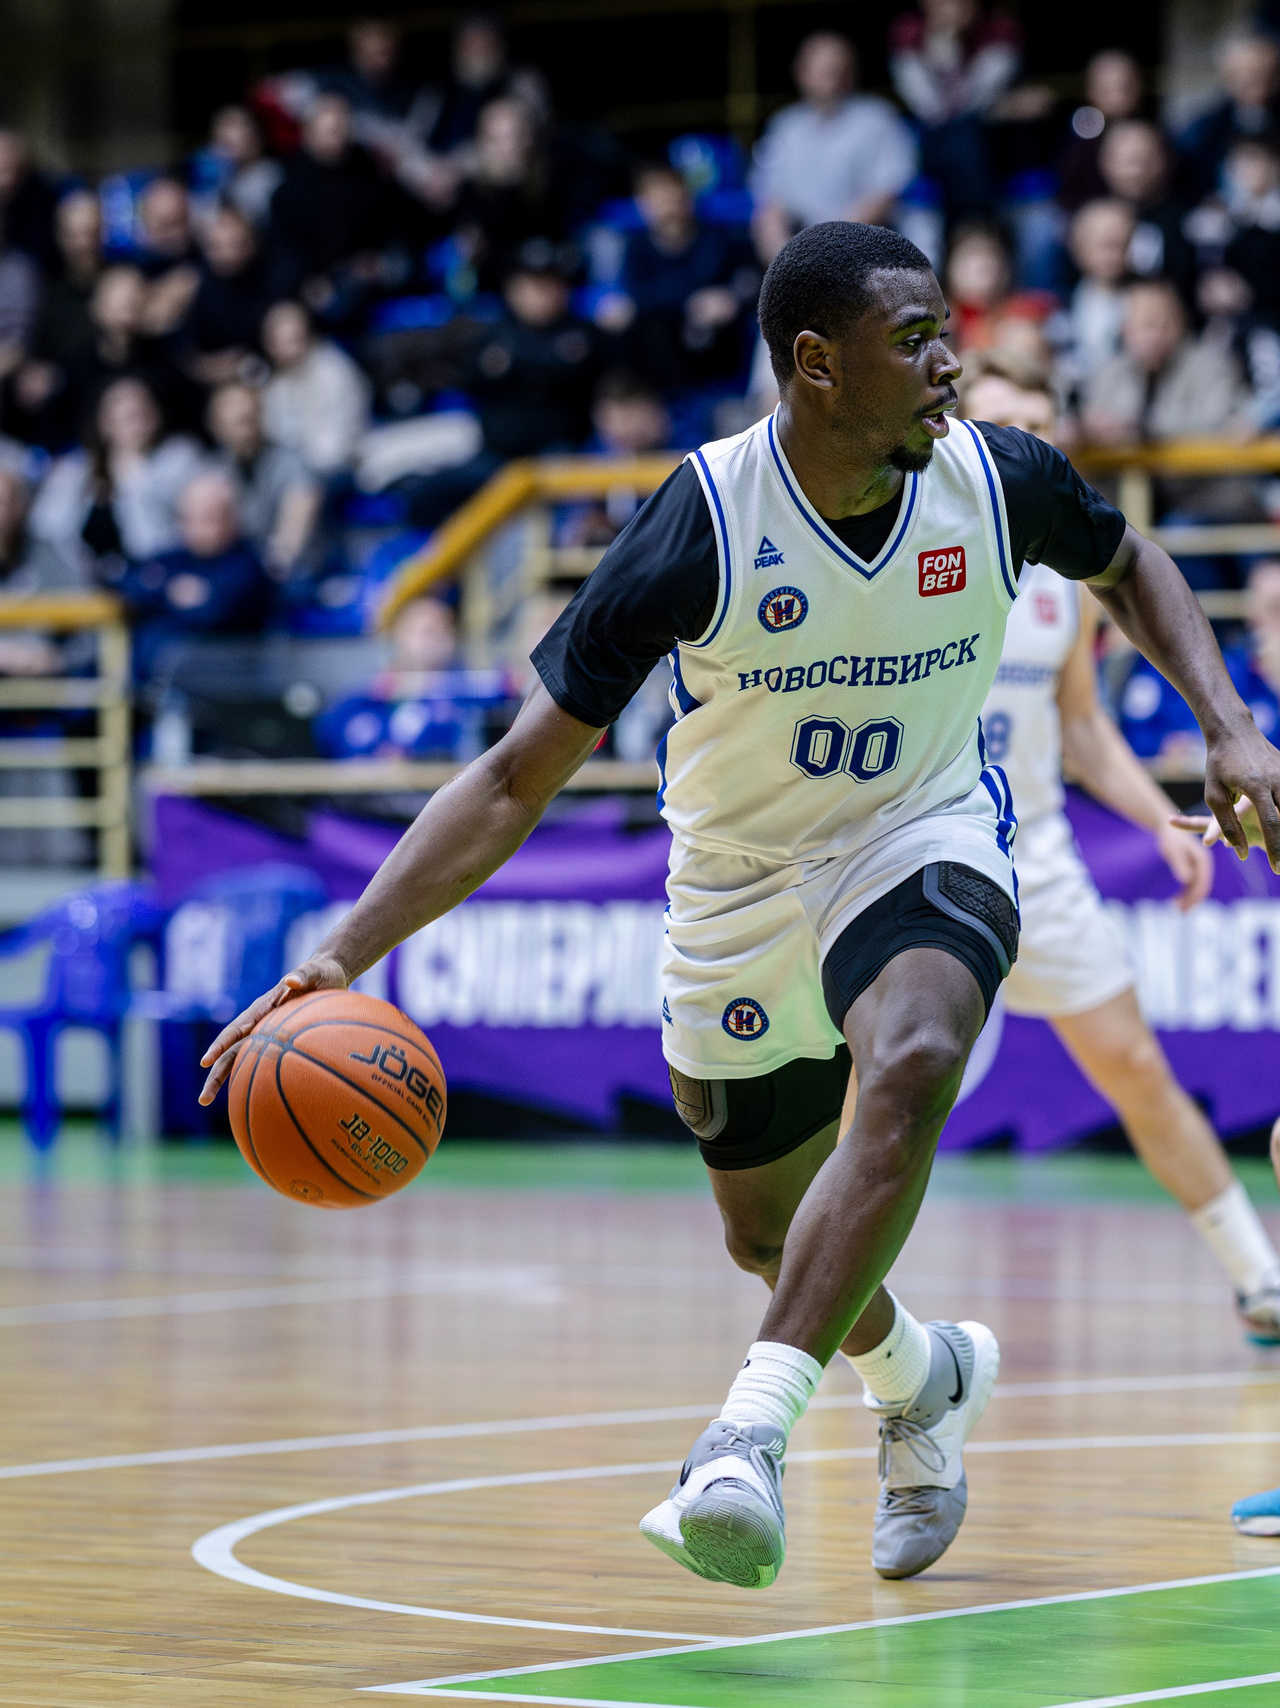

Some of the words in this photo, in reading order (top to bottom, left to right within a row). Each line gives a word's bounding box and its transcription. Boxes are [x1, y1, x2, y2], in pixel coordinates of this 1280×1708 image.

[753, 551, 785, 570] PEAK
[922, 551, 962, 574] FON
[922, 568, 963, 591] BET
[737, 632, 981, 694] НОВОСИБИРСК
[789, 713, 905, 785] 00
[349, 1044, 444, 1135] JÖGEL
[371, 1072, 405, 1100] OFFICIAL
[406, 1096, 423, 1115] GAME
[339, 1112, 409, 1175] JB-1000
